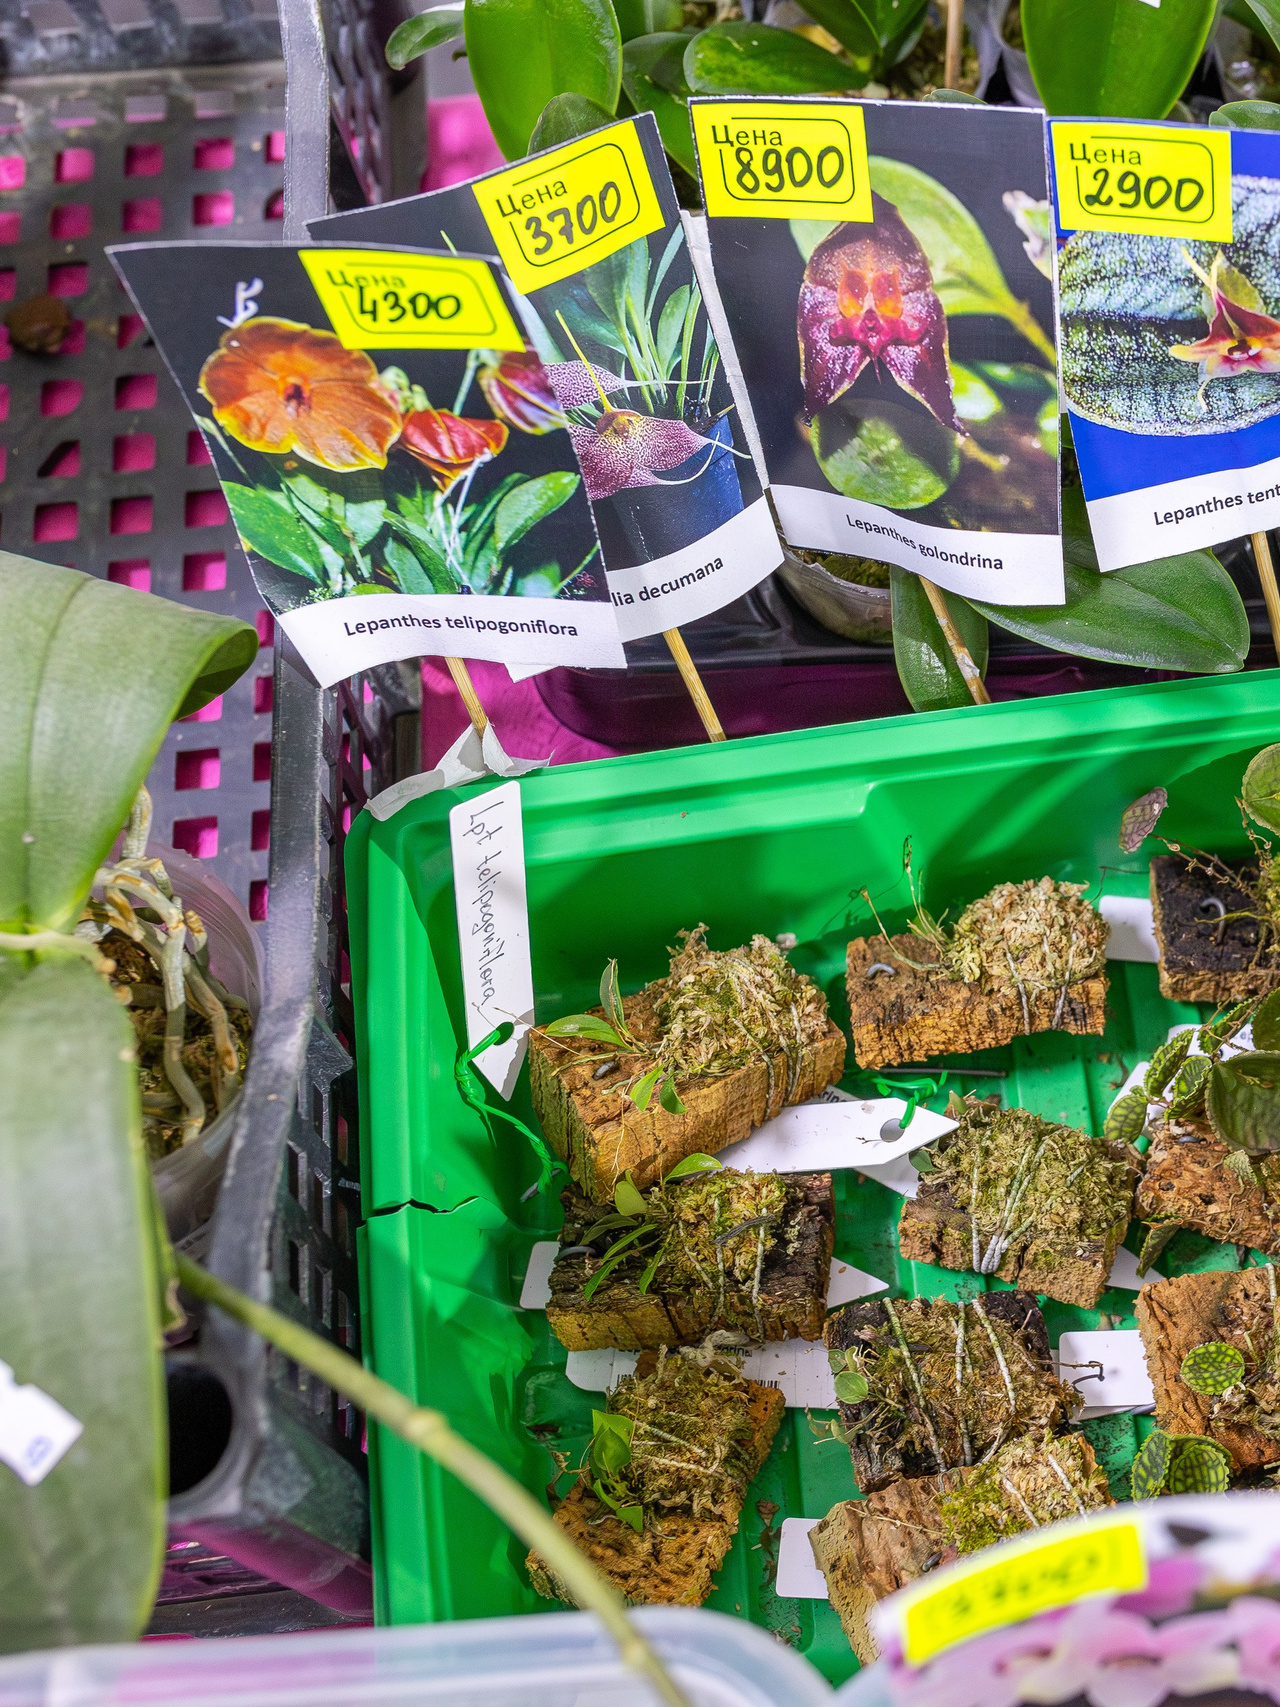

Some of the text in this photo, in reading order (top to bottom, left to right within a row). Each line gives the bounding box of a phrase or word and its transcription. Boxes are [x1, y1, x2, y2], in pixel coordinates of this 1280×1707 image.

[712, 125, 783, 147] Цена
[1070, 143, 1142, 165] Цена
[735, 146, 844, 194] 8900
[495, 180, 568, 218] Цена
[1085, 168, 1204, 212] 2900
[525, 181, 621, 256] 3700
[325, 269, 407, 289] Цена
[359, 286, 461, 322] 4300
[1153, 494, 1243, 526] Lepanthes
[846, 514, 1004, 570] Lepanthes golondrina
[638, 557, 724, 602] decumana
[344, 614, 578, 637] Lepanthes telipogoniflora
